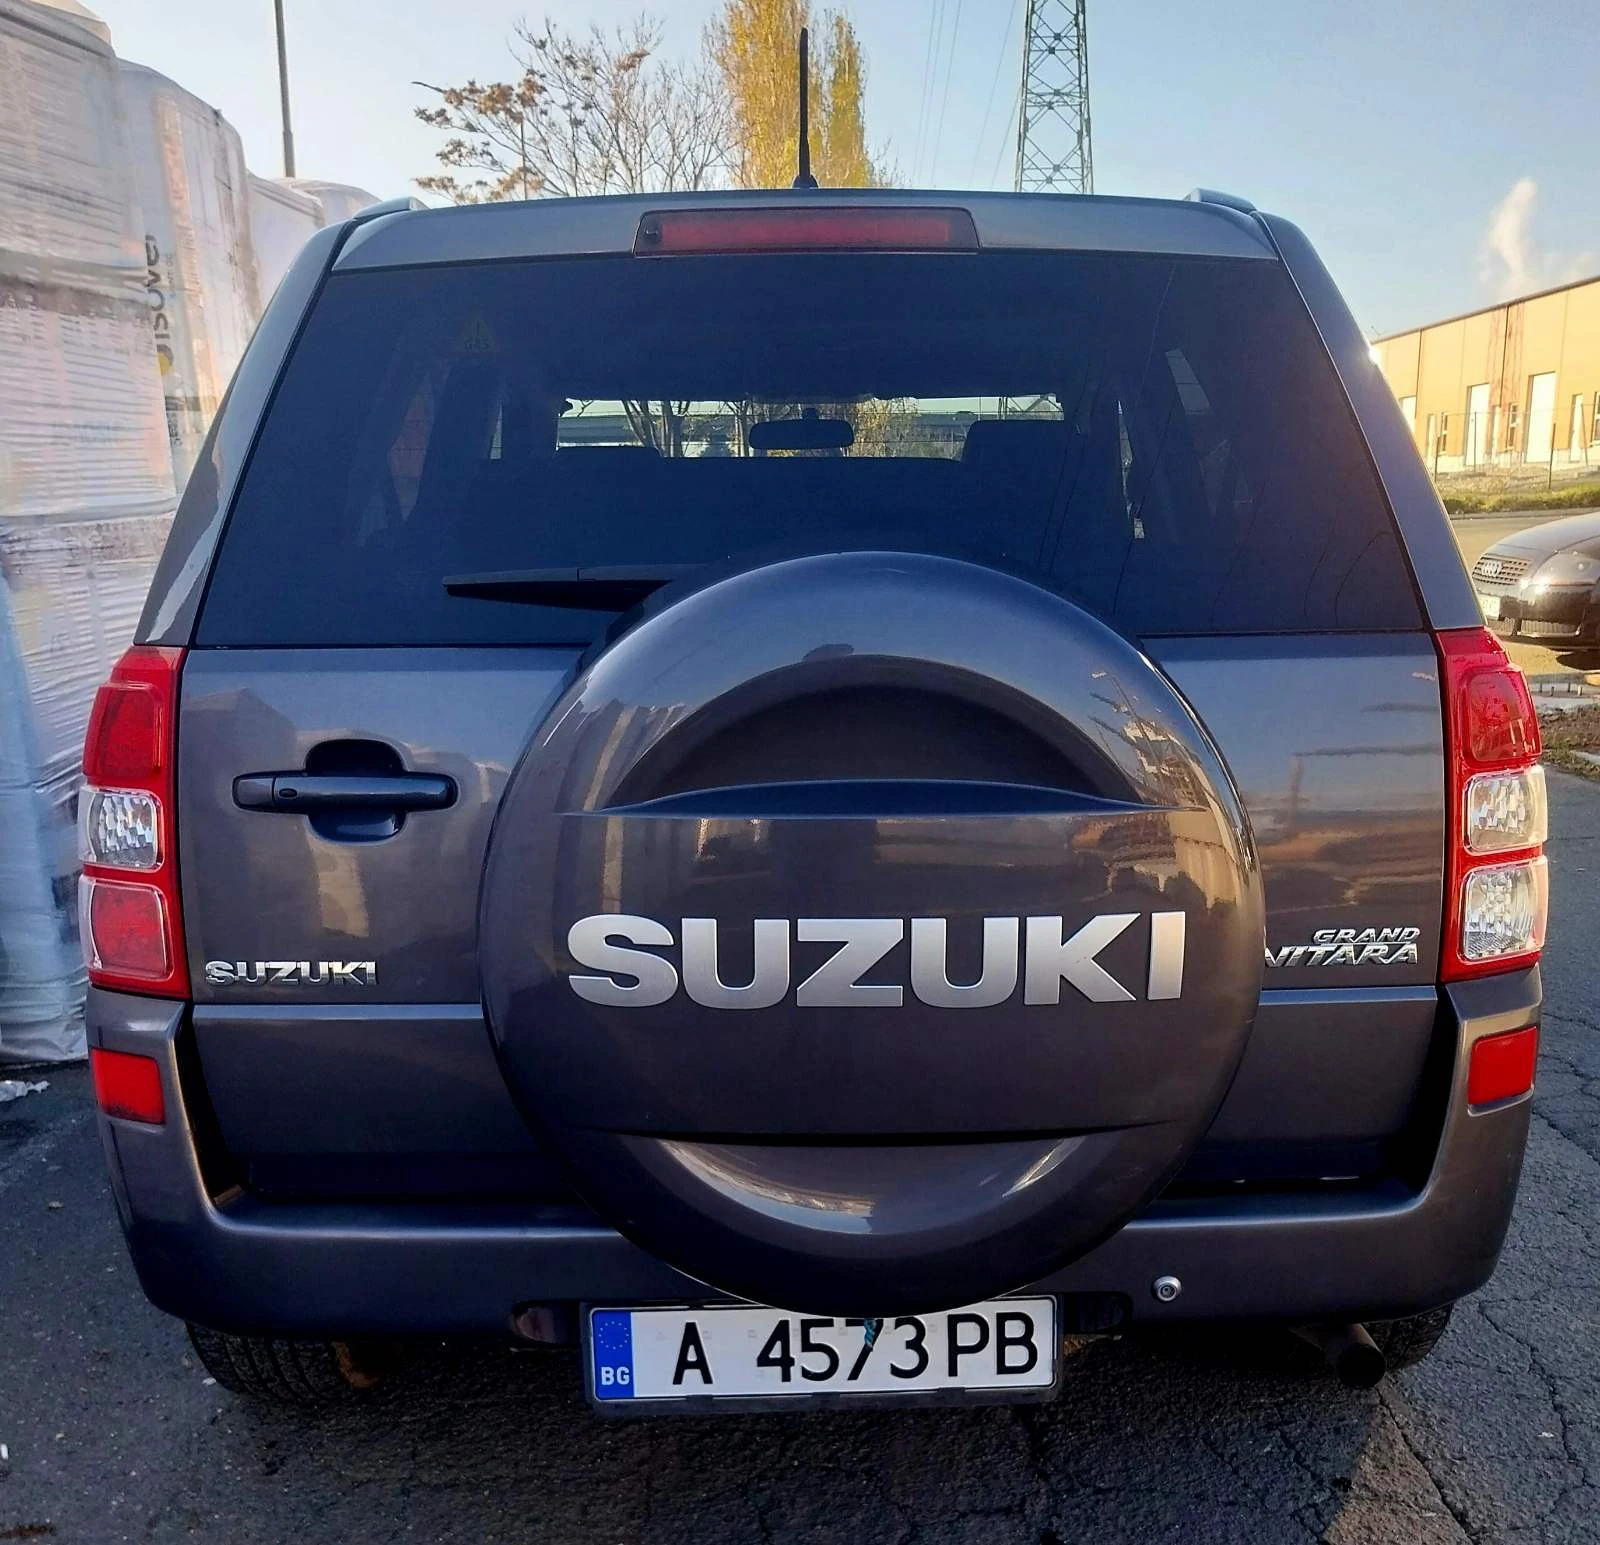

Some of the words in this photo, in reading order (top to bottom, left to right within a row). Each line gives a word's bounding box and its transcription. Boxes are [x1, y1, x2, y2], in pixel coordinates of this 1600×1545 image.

[1313, 927, 1420, 944] GRAND
[567, 911, 1186, 1009] SUZUKI
[1265, 942, 1418, 968] VITARA
[205, 960, 377, 986] SUZUKI
[672, 1321, 714, 1385] A
[756, 1316, 929, 1383] 4573
[947, 1312, 1038, 1377] PB
[601, 1366, 630, 1386] BG
